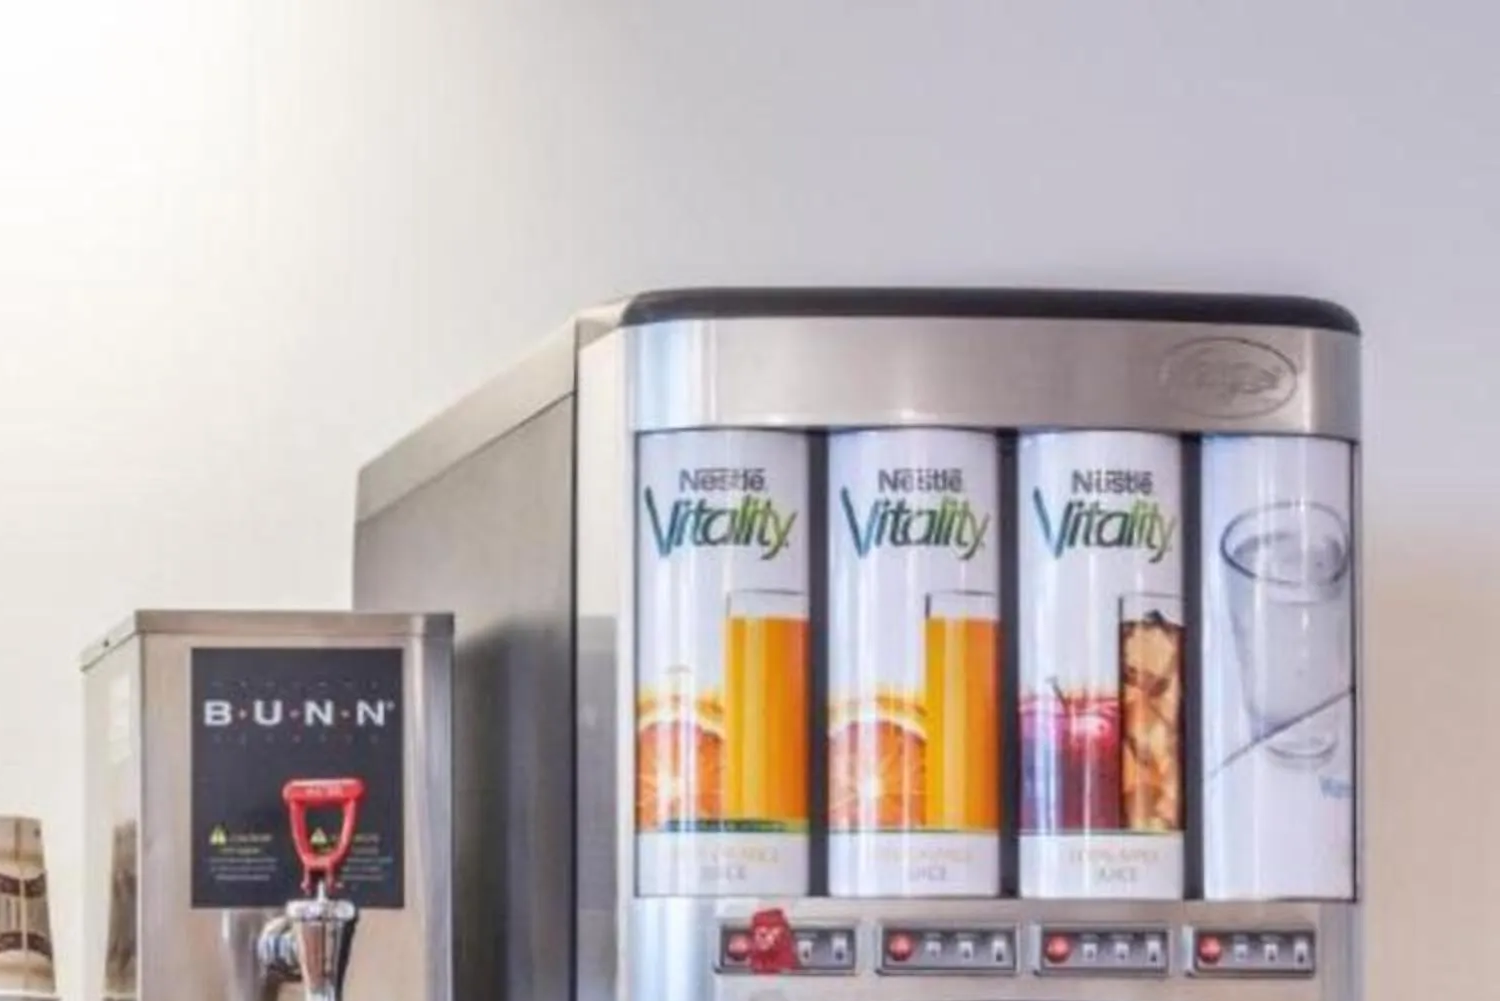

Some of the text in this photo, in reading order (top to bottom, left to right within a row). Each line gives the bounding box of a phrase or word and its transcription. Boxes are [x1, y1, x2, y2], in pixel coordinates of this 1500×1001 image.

[644, 485, 798, 561] Vitality
[840, 484, 992, 561] Vitality
[1033, 486, 1176, 563] Vitality
